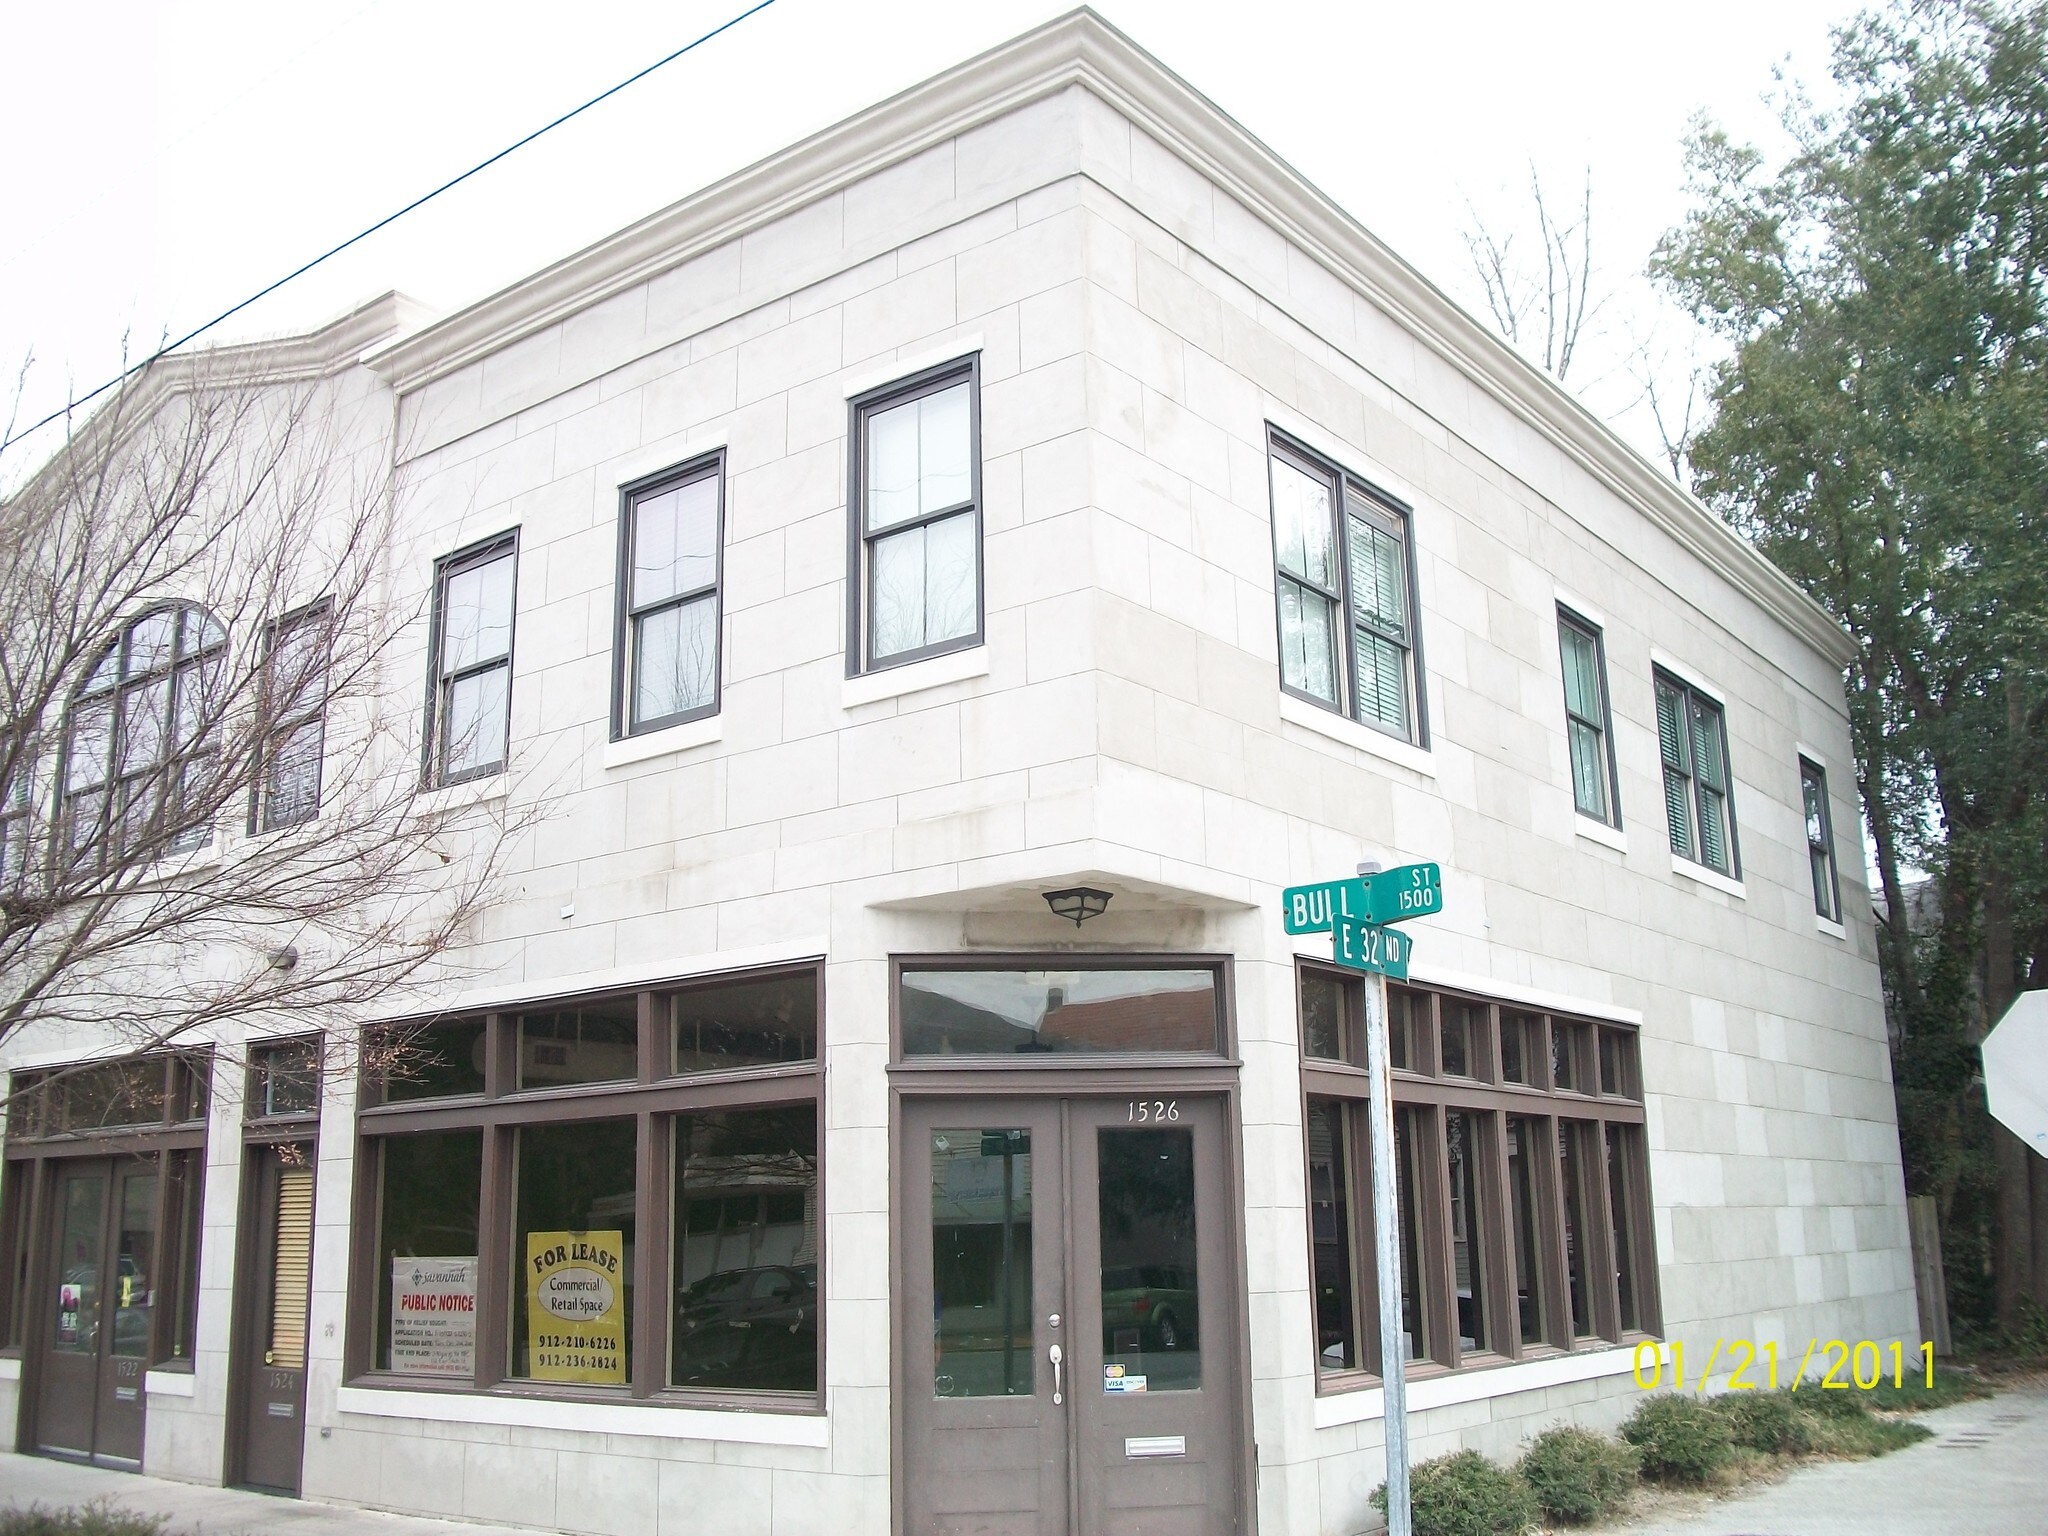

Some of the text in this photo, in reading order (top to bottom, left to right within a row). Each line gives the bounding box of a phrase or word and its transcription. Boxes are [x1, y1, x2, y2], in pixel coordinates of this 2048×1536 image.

[1292, 867, 1430, 927] BULL ST
[1398, 888, 1433, 910] 1500
[1342, 923, 1352, 959] E
[1360, 927, 1378, 966] 32
[1385, 935, 1399, 963] ND
[1127, 1100, 1179, 1122] 1526
[533, 1243, 618, 1275] FOR LEASE
[549, 1277, 603, 1291] Commercial/
[401, 1294, 475, 1312] PUBLIC NOTICE
[551, 1297, 603, 1315] Retail Space
[539, 1335, 616, 1350] 912-210-6226
[539, 1353, 617, 1370] 912-236-2824
[269, 1372, 294, 1390] 1524
